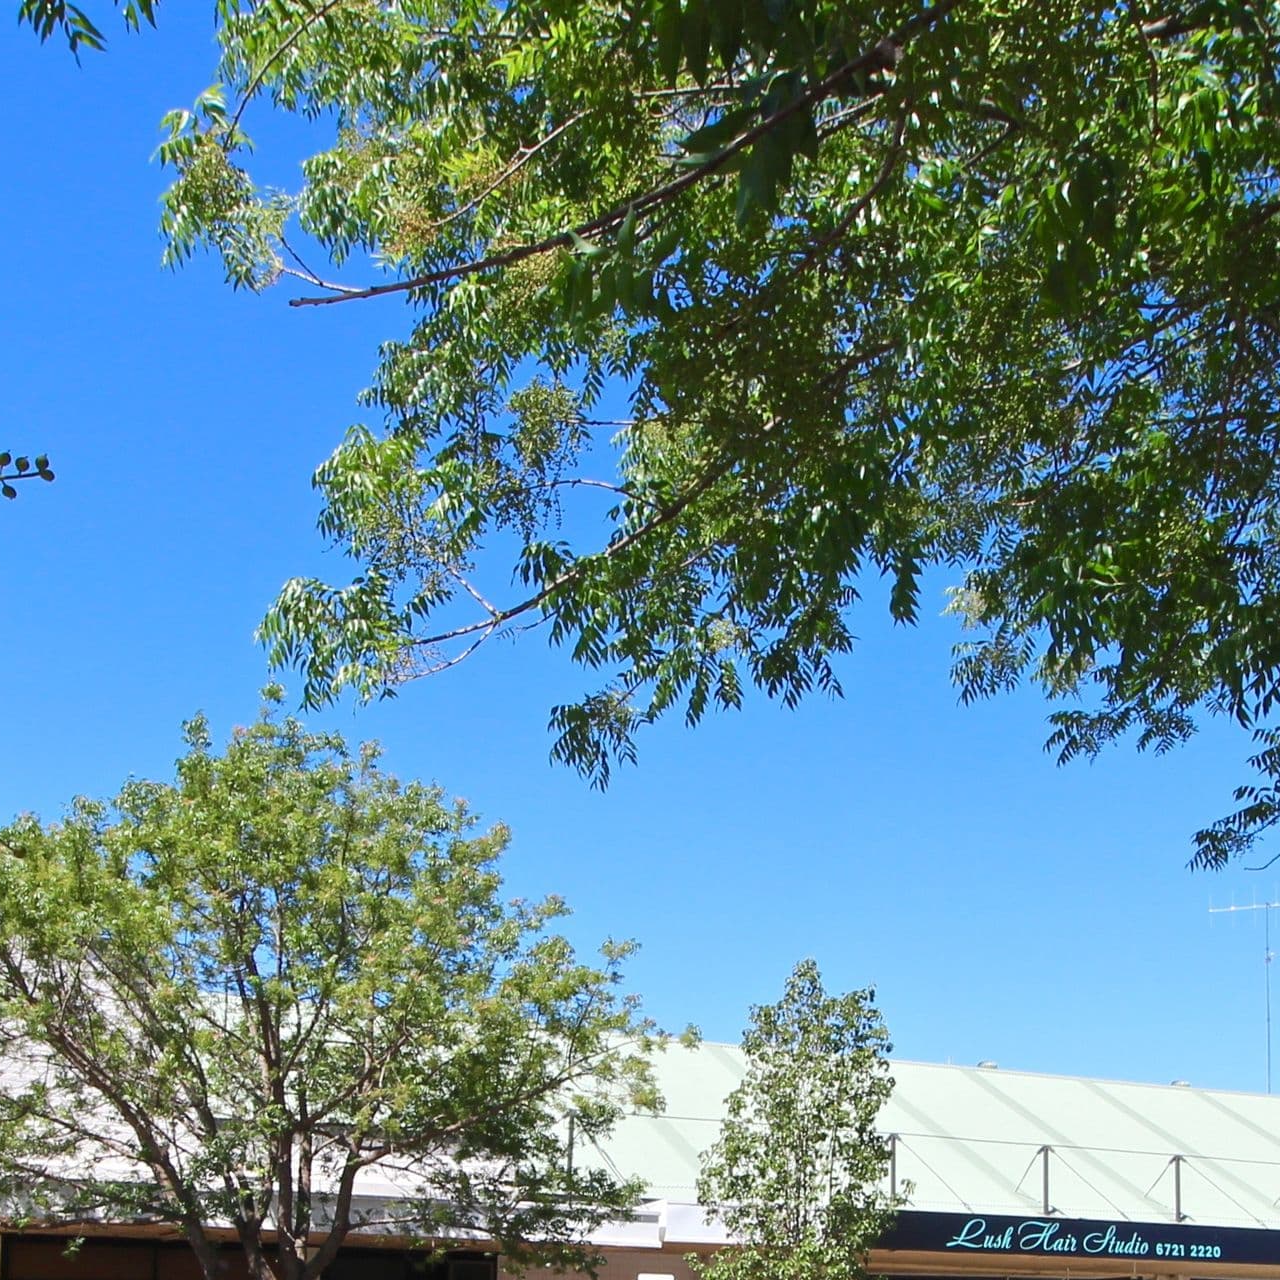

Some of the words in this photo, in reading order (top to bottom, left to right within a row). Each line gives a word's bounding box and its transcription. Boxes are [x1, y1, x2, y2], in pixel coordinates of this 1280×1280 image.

[945, 1218, 1014, 1249] Lush
[1017, 1221, 1077, 1252] Hair
[1083, 1225, 1149, 1255] Studio
[1155, 1242, 1185, 1257] 6721
[1190, 1245, 1221, 1258] 2220
